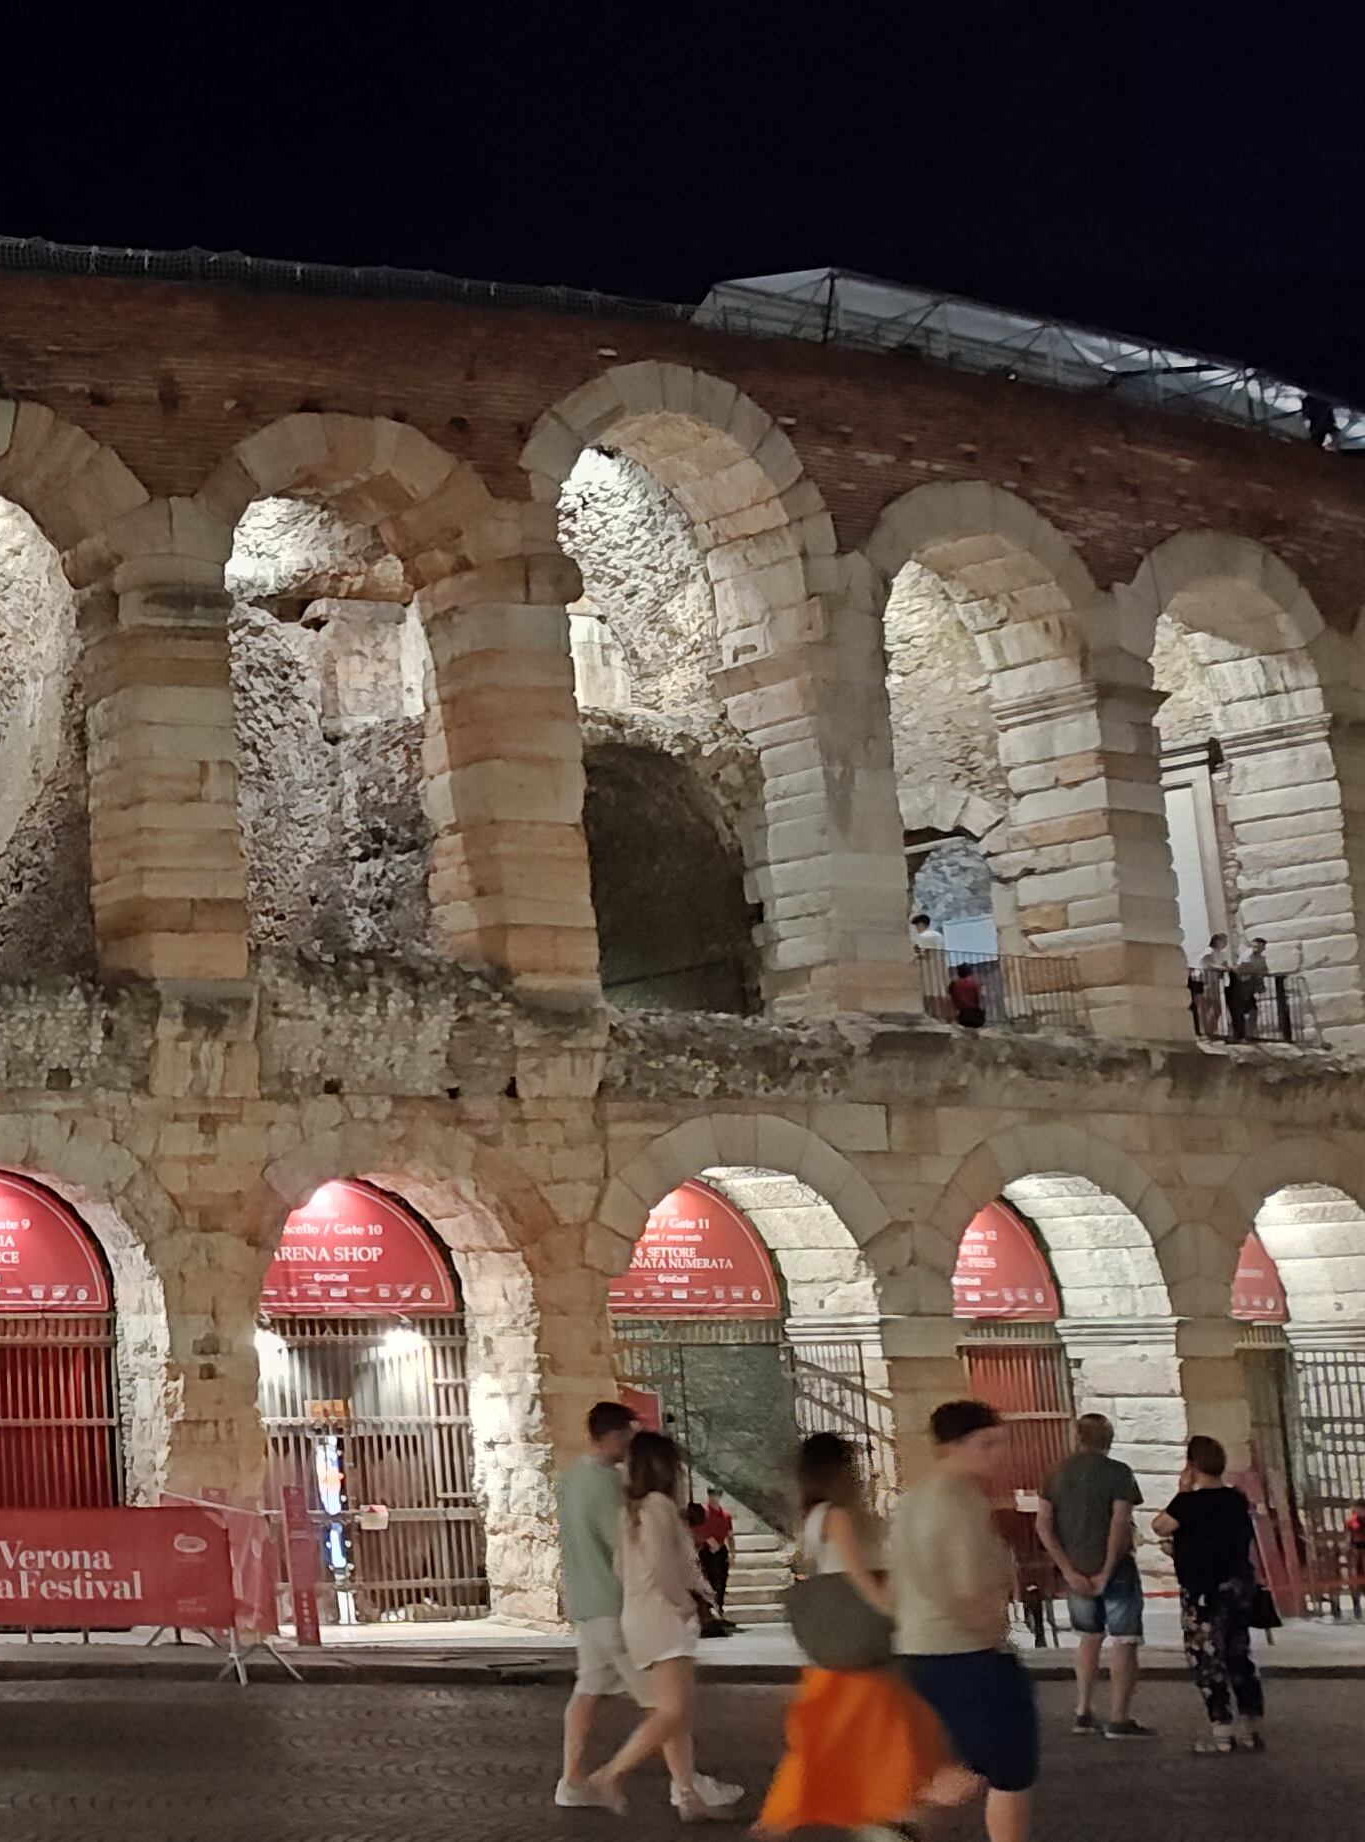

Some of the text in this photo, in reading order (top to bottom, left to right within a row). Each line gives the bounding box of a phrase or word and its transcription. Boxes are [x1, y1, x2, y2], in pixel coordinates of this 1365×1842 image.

[21, 1218, 31, 1230] 9
[333, 1224, 364, 1236] Gate
[367, 1224, 383, 1236] 10
[669, 1218, 696, 1229] Gate
[698, 1218, 710, 1230] 11
[333, 1246, 384, 1262] SHOP
[646, 1247, 697, 1258] SETTORE
[668, 1257, 734, 1270] NUMERATA
[18, 1570, 143, 1601] Festival
